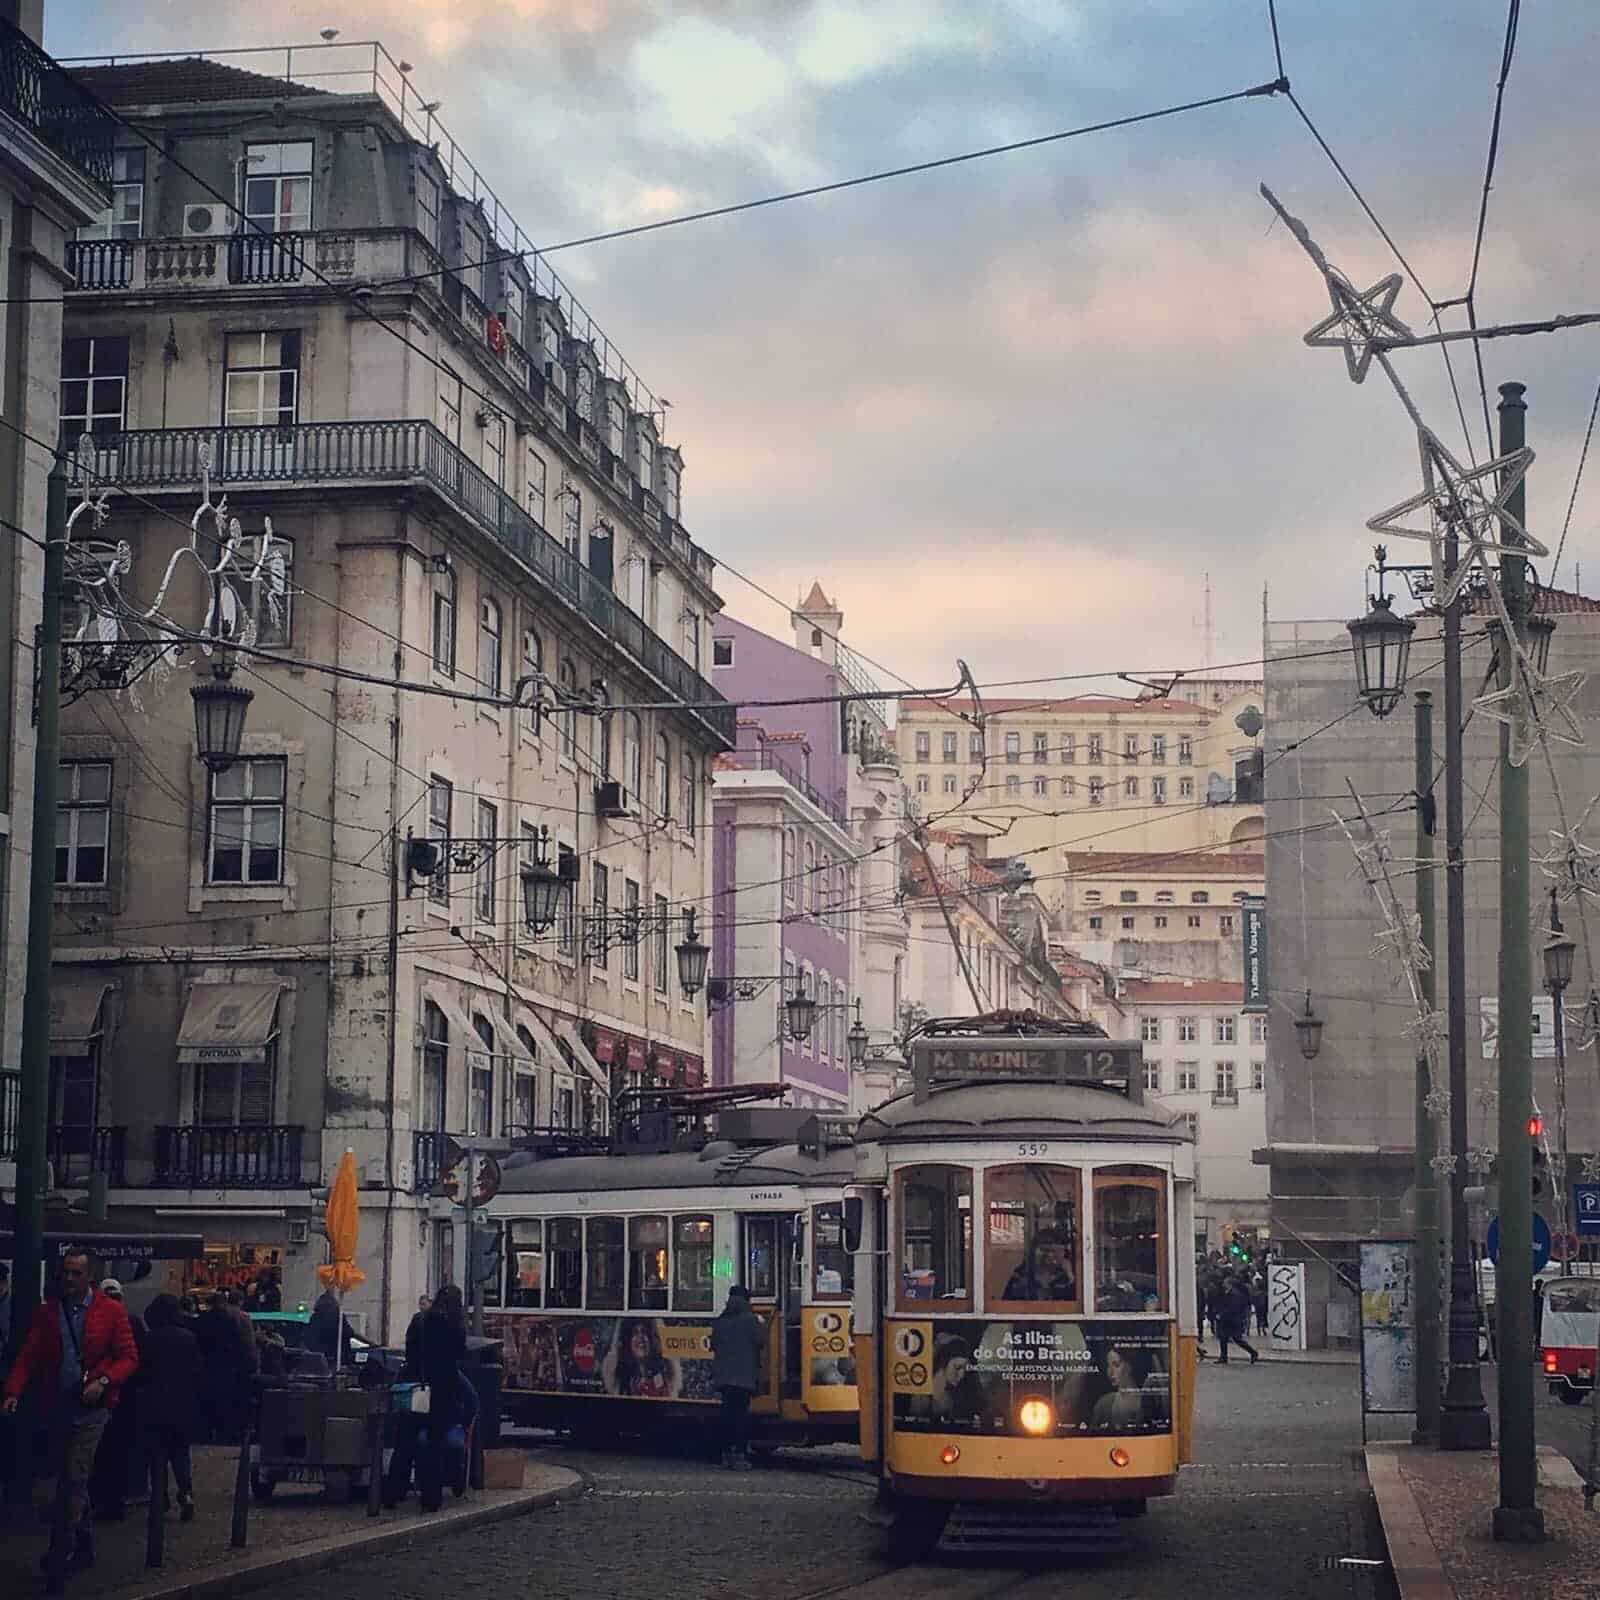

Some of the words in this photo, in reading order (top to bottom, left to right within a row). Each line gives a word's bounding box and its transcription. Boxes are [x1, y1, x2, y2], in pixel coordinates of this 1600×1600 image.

[968, 1050, 1044, 1069] MONIZ
[1083, 1051, 1115, 1076] 12
[1018, 1143, 1049, 1156] 559
[1003, 1331, 1022, 1345] As
[1025, 1331, 1062, 1345] Ilhas
[973, 1345, 993, 1359] do
[996, 1347, 1035, 1360] Ouro
[1038, 1347, 1092, 1361] Branco
